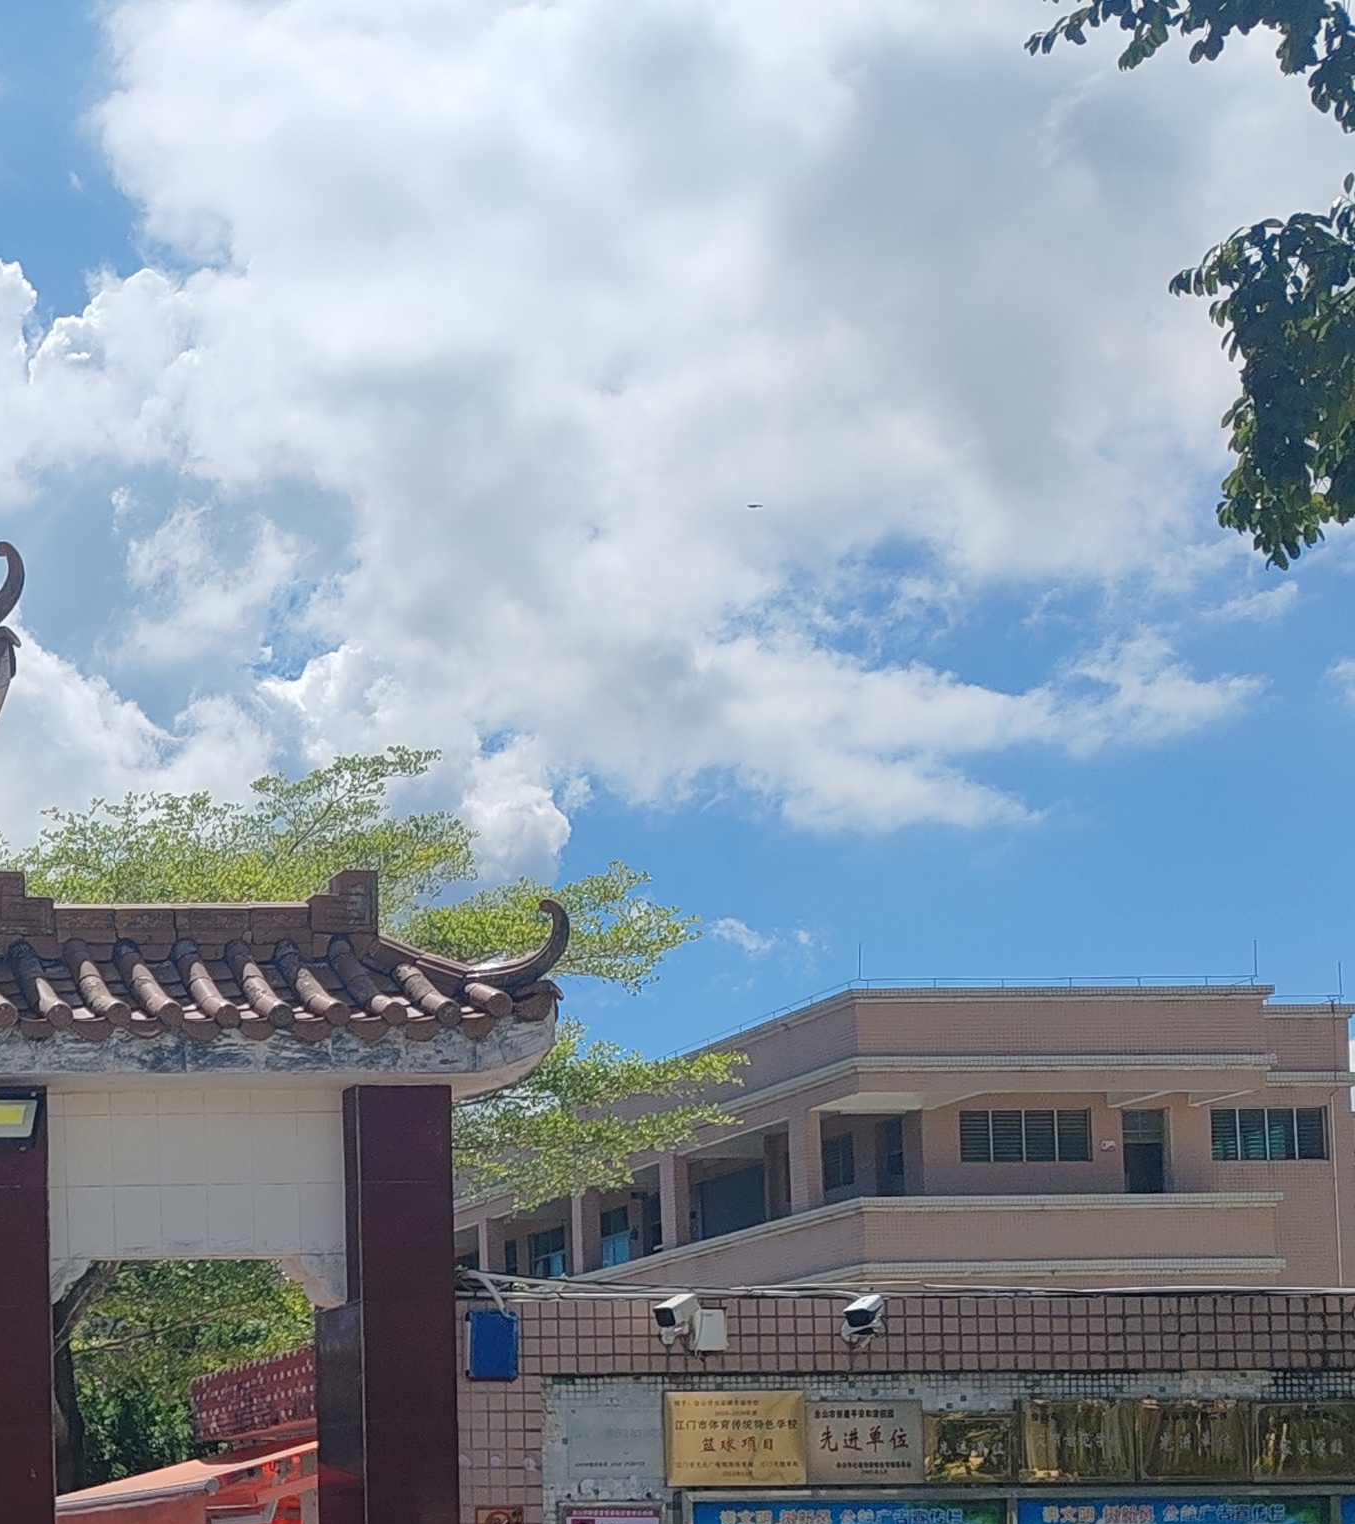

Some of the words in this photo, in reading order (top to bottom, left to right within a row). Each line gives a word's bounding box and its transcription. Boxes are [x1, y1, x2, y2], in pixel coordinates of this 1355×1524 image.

[675, 1419, 798, 1431] 江门市体育传统特色学校
[700, 1435, 775, 1453] 篮球项目
[819, 1424, 910, 1453] 先进单位
